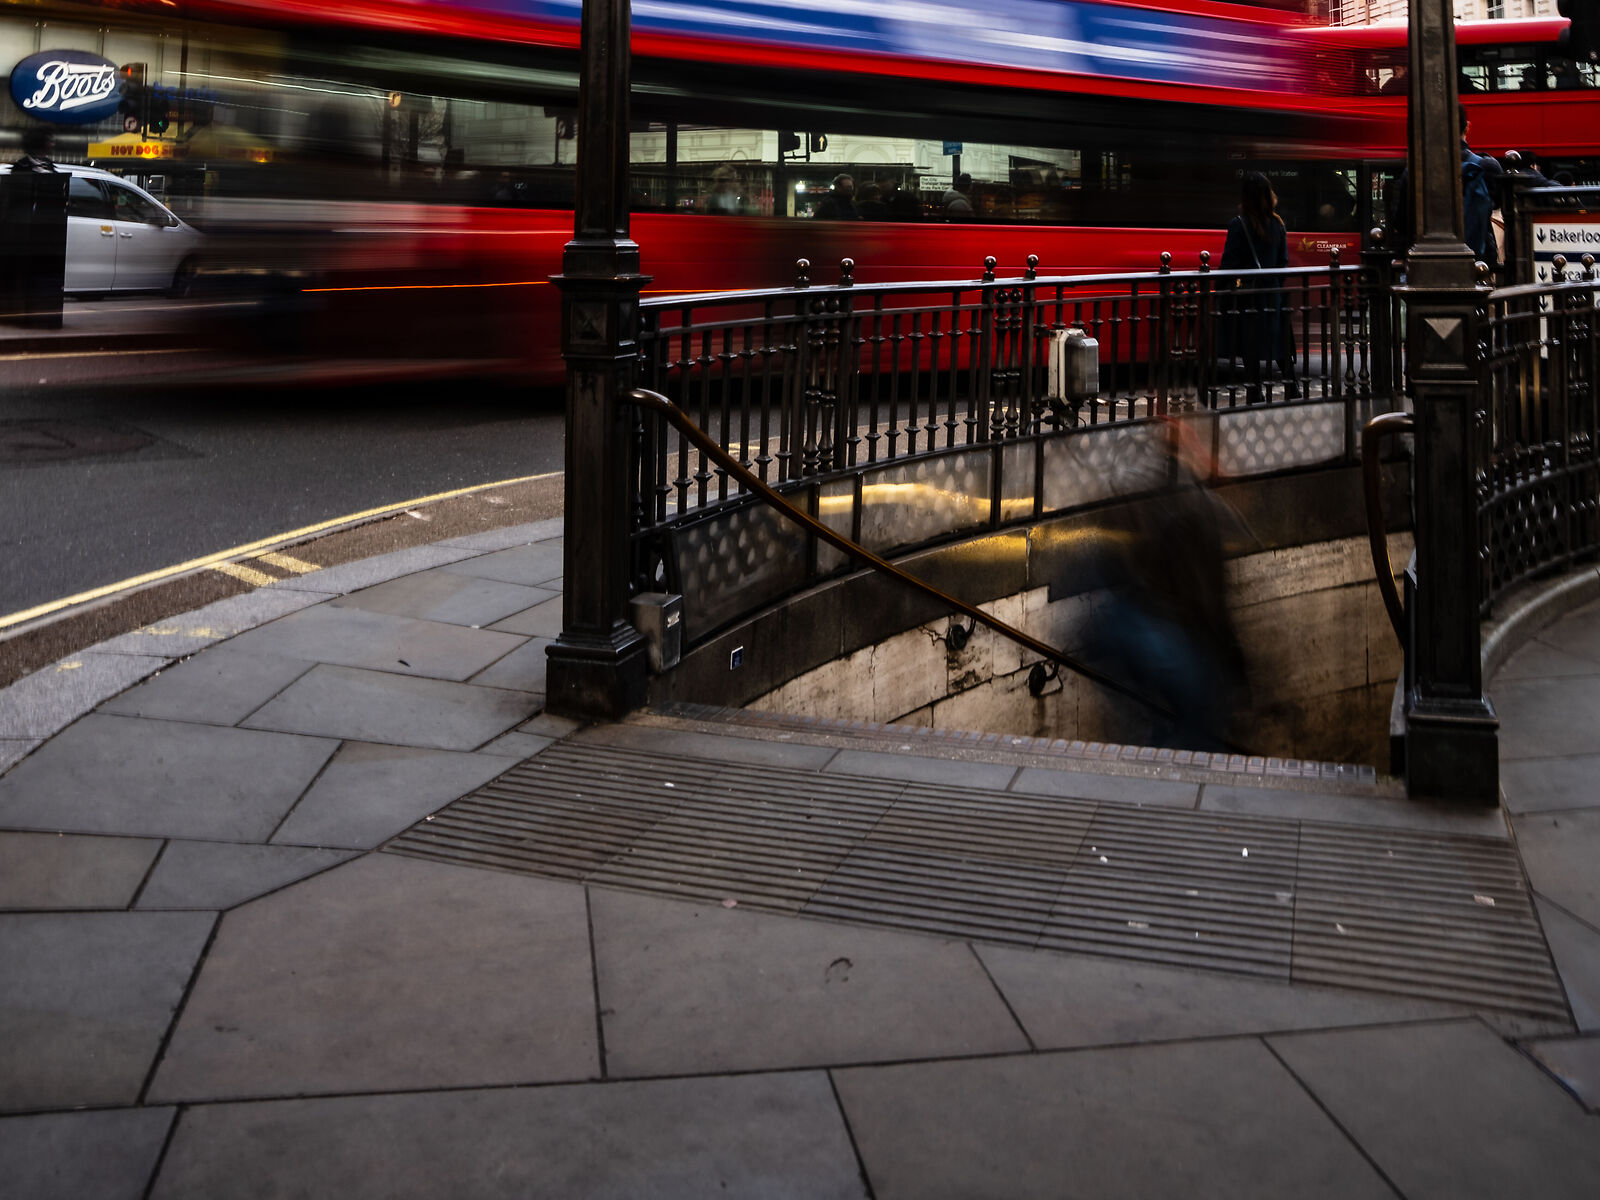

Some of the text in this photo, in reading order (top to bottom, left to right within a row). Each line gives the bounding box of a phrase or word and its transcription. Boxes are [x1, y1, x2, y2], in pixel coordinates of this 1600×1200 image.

[22, 60, 116, 111] Boots
[110, 145, 134, 156] HOT
[136, 145, 160, 156] DOG
[1549, 228, 1600, 244] Bakerloo
